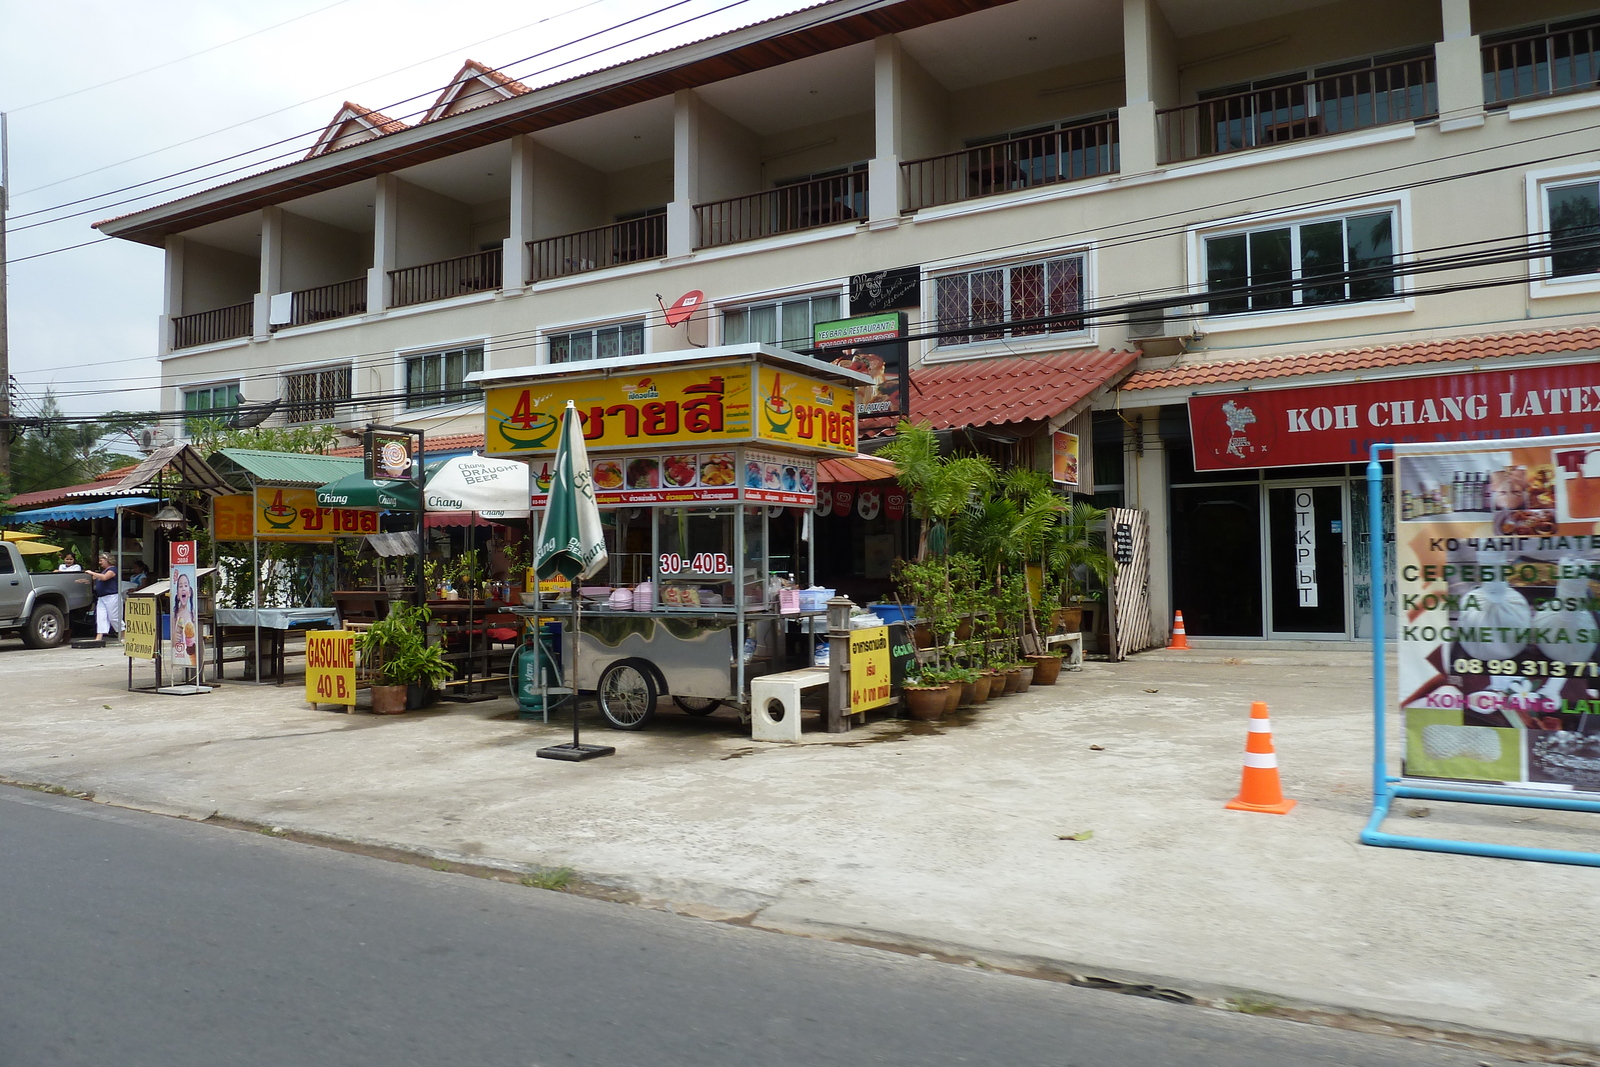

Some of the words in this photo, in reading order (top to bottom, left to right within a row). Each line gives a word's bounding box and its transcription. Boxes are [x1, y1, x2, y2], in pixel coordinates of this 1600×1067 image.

[818, 330, 829, 340] YES
[830, 328, 843, 338] BAR
[843, 328, 848, 336] &
[848, 321, 890, 335] RESTAURANT
[865, 401, 891, 412] AWAY
[1286, 404, 1358, 433] KOH
[1368, 394, 1488, 427] CHANG
[461, 465, 519, 478] DRAUGHT
[465, 474, 499, 485] BEER
[318, 493, 348, 505] Chang
[378, 494, 397, 507] Chang
[428, 496, 463, 509] Chang
[1296, 492, 1317, 602] ОТКРЫТ
[1430, 537, 1459, 551] КО
[1467, 537, 1529, 551] ЧАНГ
[1403, 564, 1538, 582] СЕРЕБРО
[129, 601, 151, 616] FRIED
[1402, 594, 1481, 611] КОЖА
[126, 619, 153, 636] BANANA
[1403, 626, 1572, 643] КОСМЕТИКА
[125, 638, 152, 655] กล้วยทอด
[308, 638, 353, 668] GASOLINE
[1453, 658, 1483, 674] 08
[1487, 659, 1517, 675] 99
[1521, 660, 1567, 676] 313
[317, 674, 332, 698] 40
[336, 675, 349, 698] B.
[1427, 694, 1469, 709] KOH
[1478, 695, 1556, 712] CHANG
